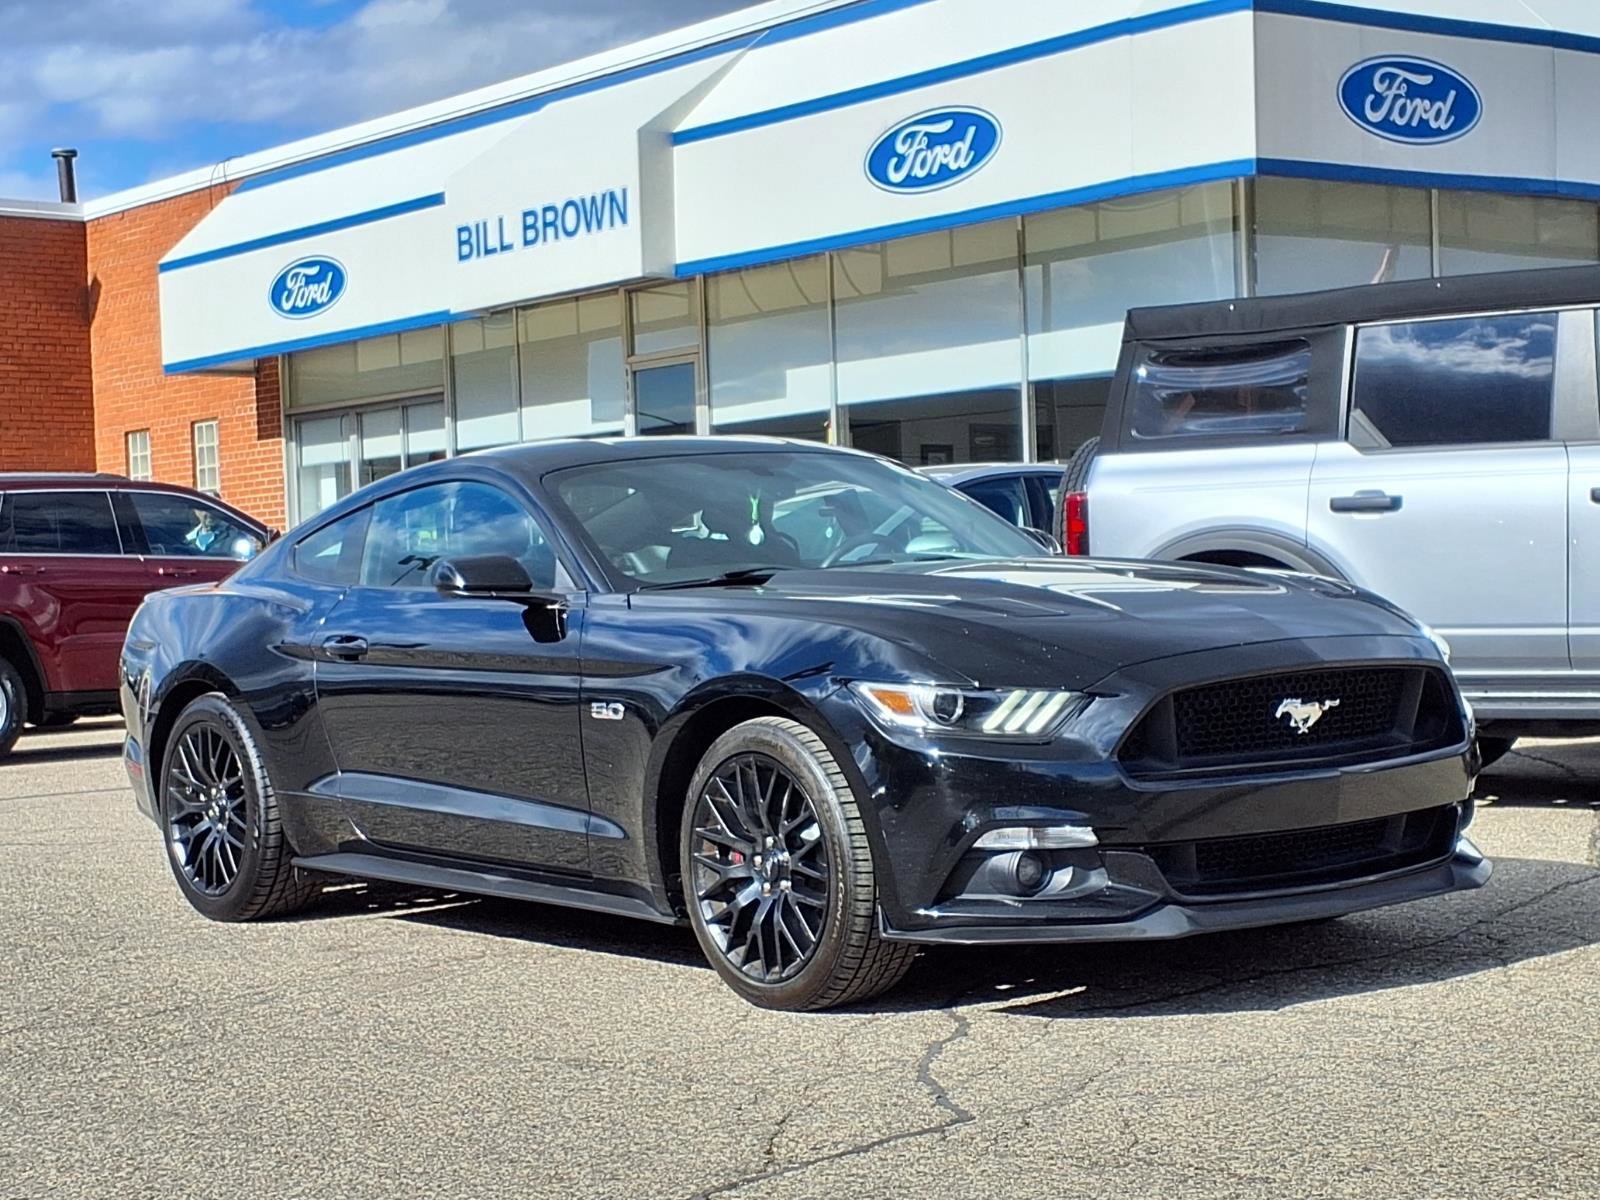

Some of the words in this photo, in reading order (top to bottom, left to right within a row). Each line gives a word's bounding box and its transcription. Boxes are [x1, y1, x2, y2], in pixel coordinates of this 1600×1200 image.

[1364, 66, 1457, 131] Ford
[886, 118, 977, 184] Ford
[456, 216, 514, 262] BILL
[521, 187, 628, 247] BROWN
[281, 264, 334, 311] Ford
